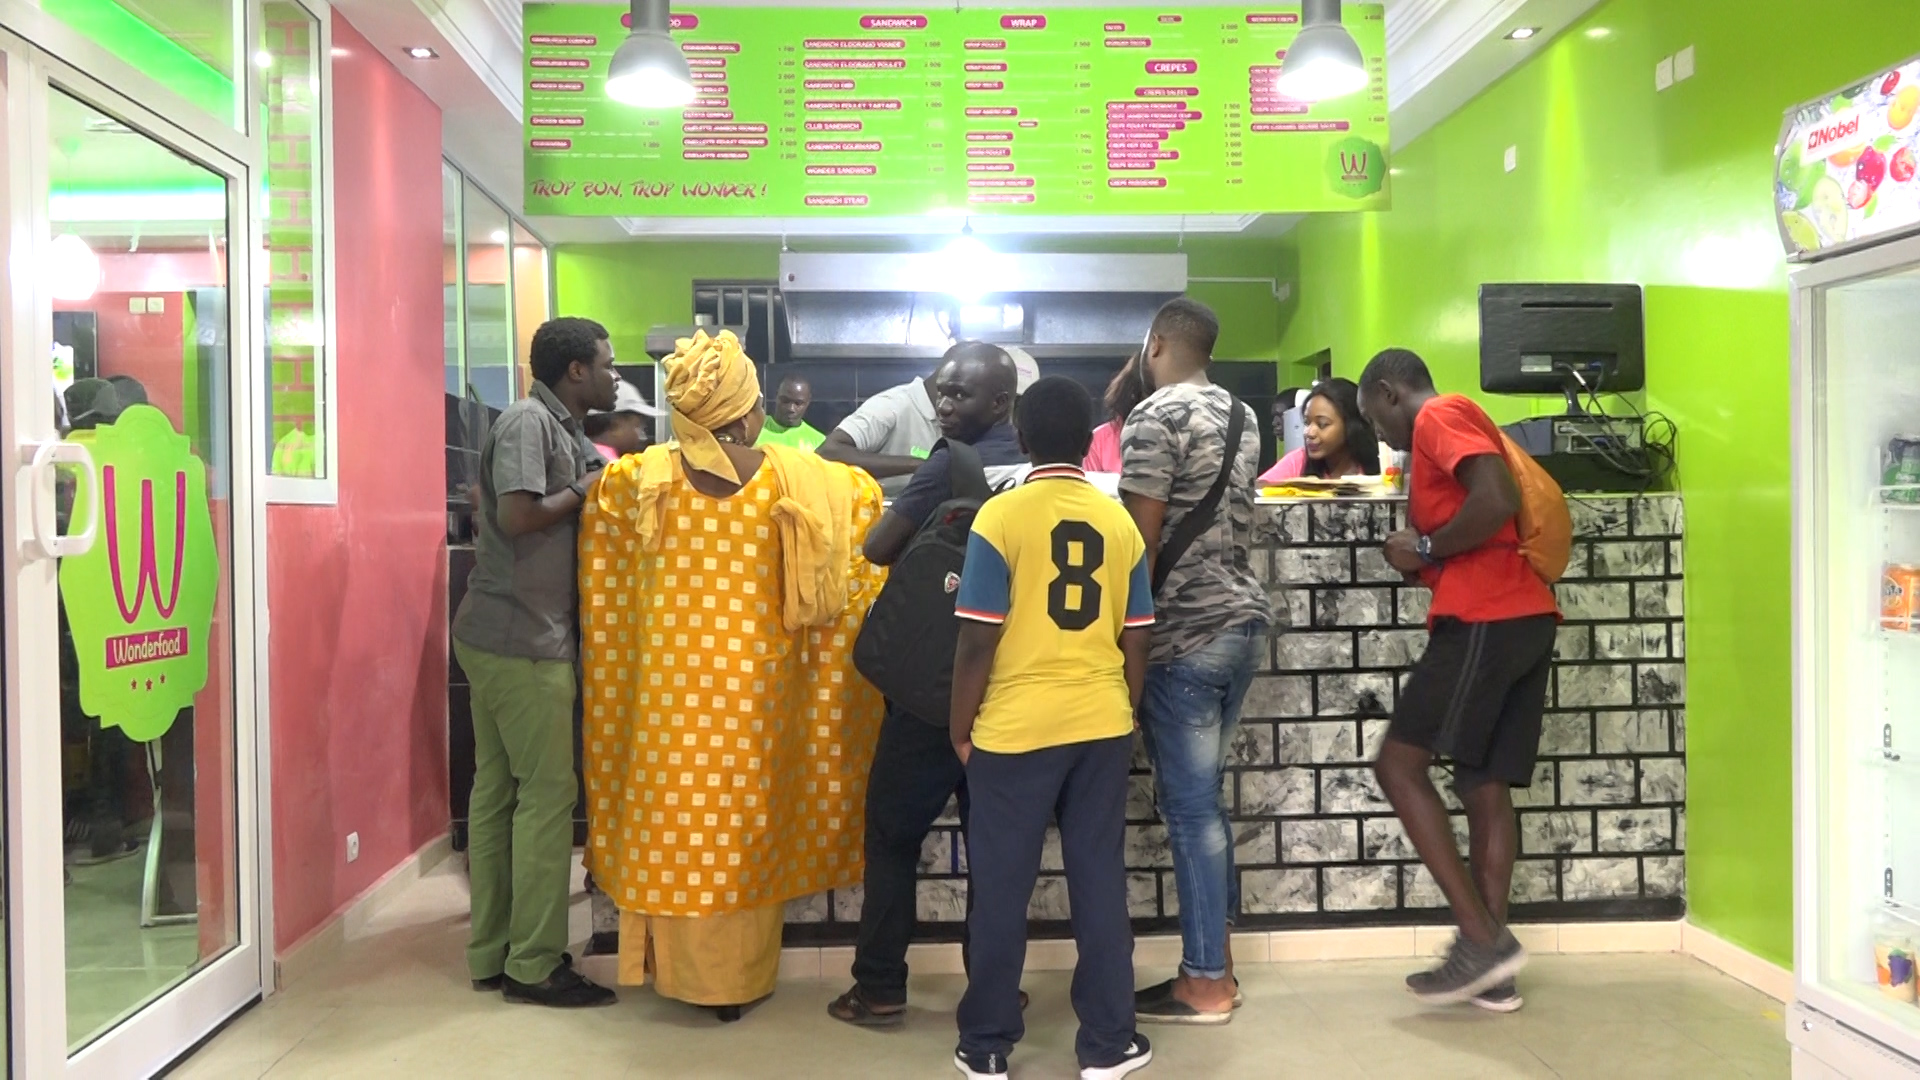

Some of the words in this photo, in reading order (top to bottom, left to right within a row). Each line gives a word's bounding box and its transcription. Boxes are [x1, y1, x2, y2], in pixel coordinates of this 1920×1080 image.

[871, 19, 917, 27] SANDWICH
[1010, 19, 1038, 27] WRAP
[1154, 63, 1188, 72] CREPES
[805, 121, 823, 130] CLUB
[824, 121, 859, 130] SANDWICH
[1818, 113, 1860, 146] Nobel
[530, 180, 576, 198] TROP
[630, 180, 675, 198] TROP
[682, 181, 757, 199] WONDER
[103, 464, 186, 624] W
[1047, 519, 1104, 631] 8
[112, 630, 181, 664] Wonderfood
